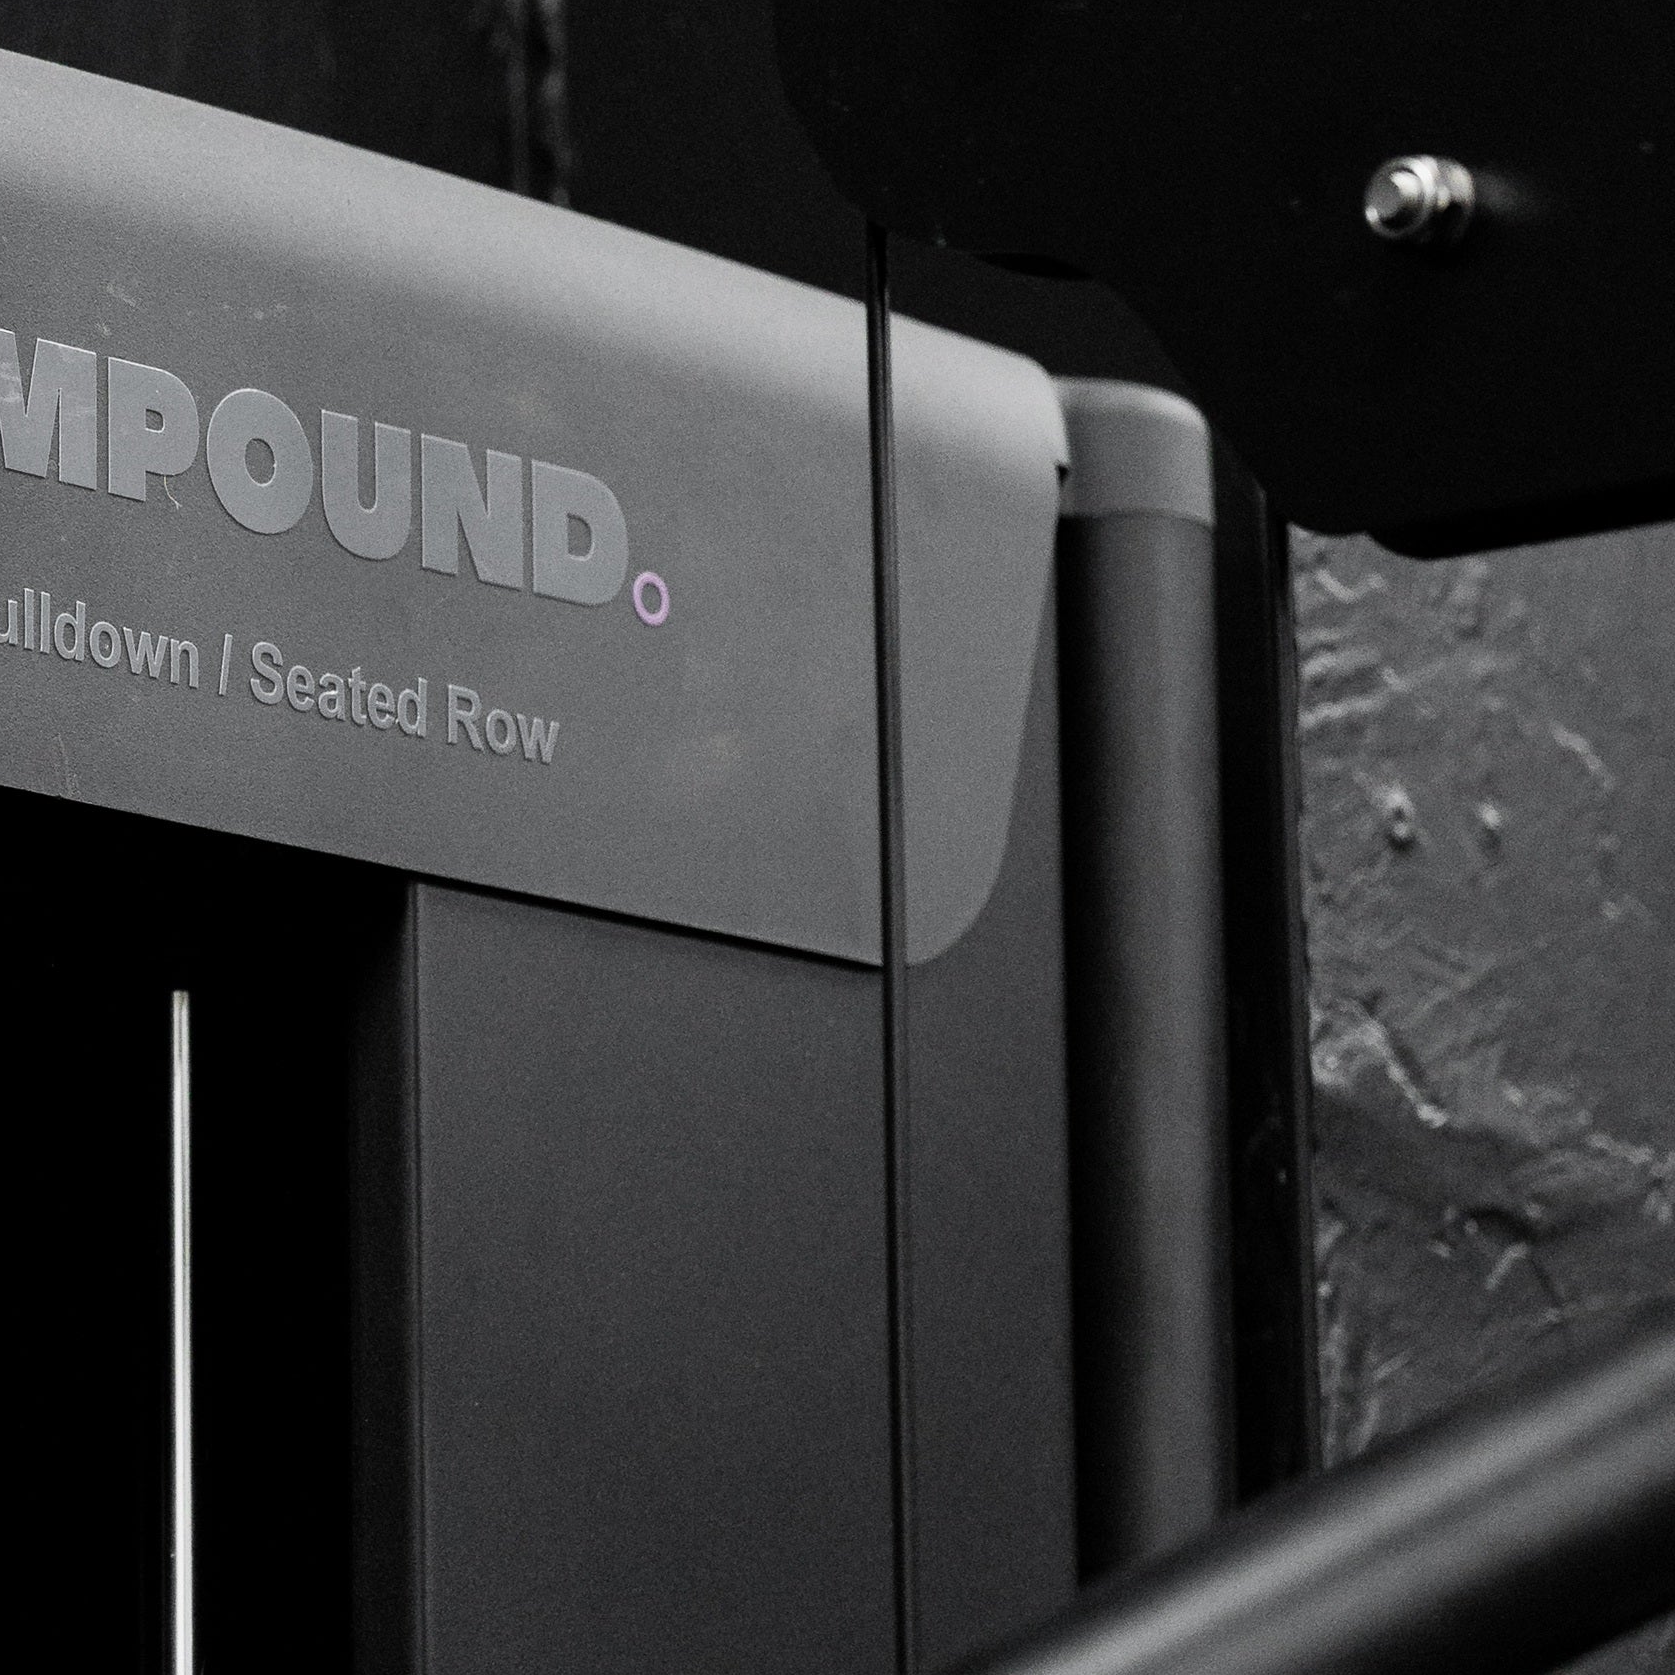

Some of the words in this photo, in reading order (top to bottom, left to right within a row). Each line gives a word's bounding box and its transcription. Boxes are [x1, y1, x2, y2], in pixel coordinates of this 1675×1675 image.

[216, 632, 234, 697] /
[250, 640, 429, 739] Seated
[446, 682, 561, 764] Row
